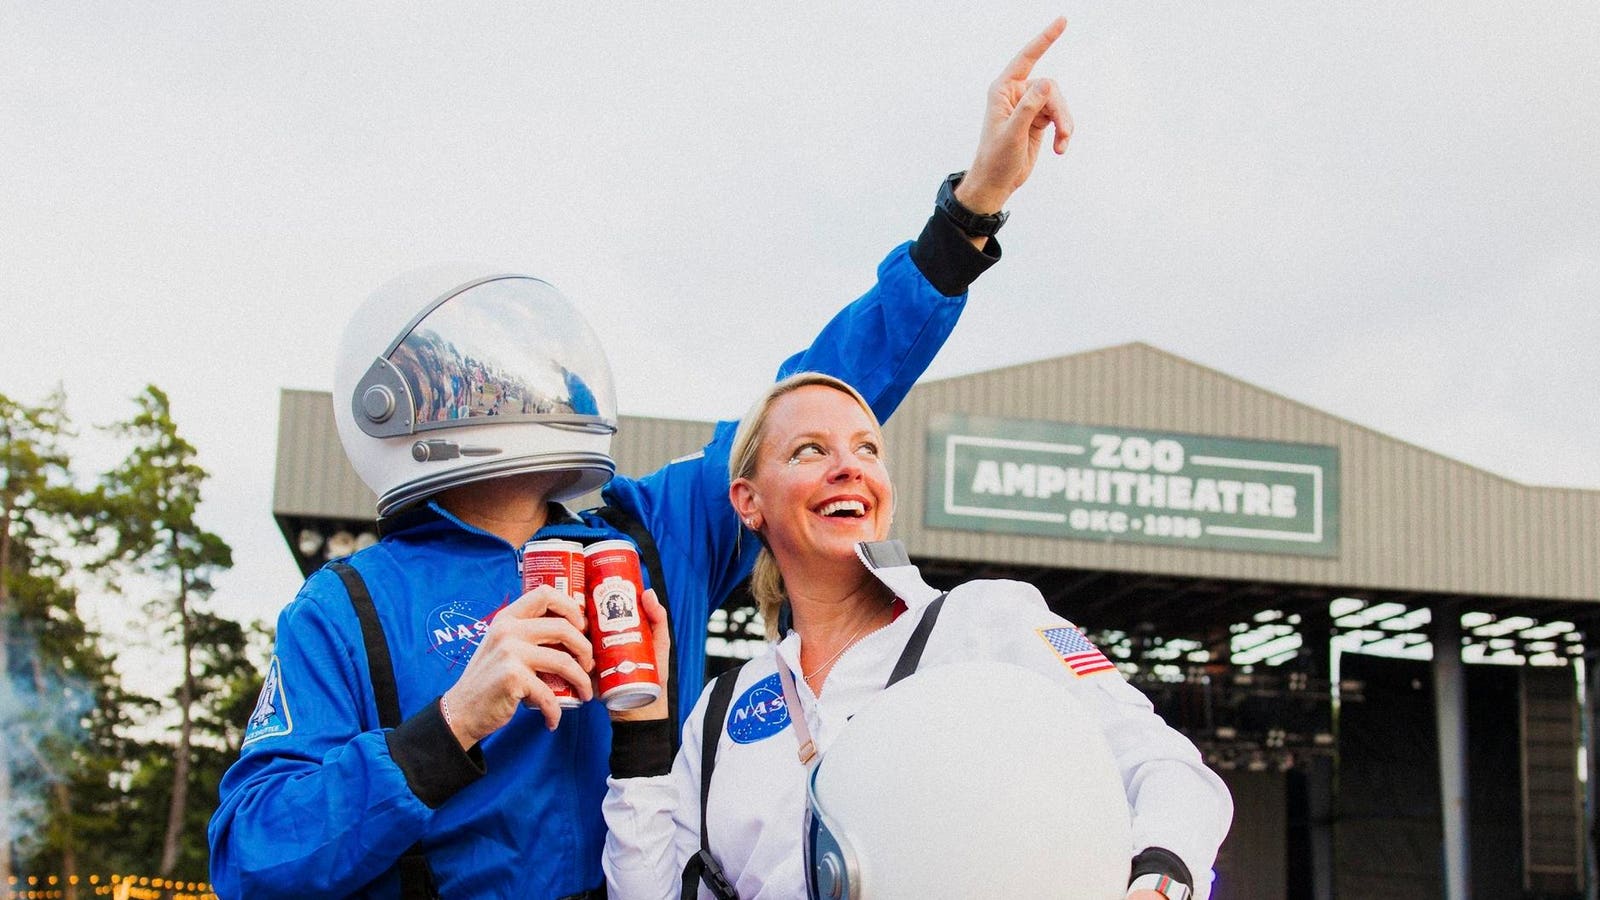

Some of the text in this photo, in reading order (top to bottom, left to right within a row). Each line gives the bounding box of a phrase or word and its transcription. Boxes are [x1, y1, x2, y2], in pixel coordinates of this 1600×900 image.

[1090, 433, 1185, 473] ZOO
[971, 460, 1297, 518] AMPHITHEATRE
[1069, 508, 1128, 533] OKC
[433, 620, 489, 645] NAS
[734, 696, 785, 724] NAS
